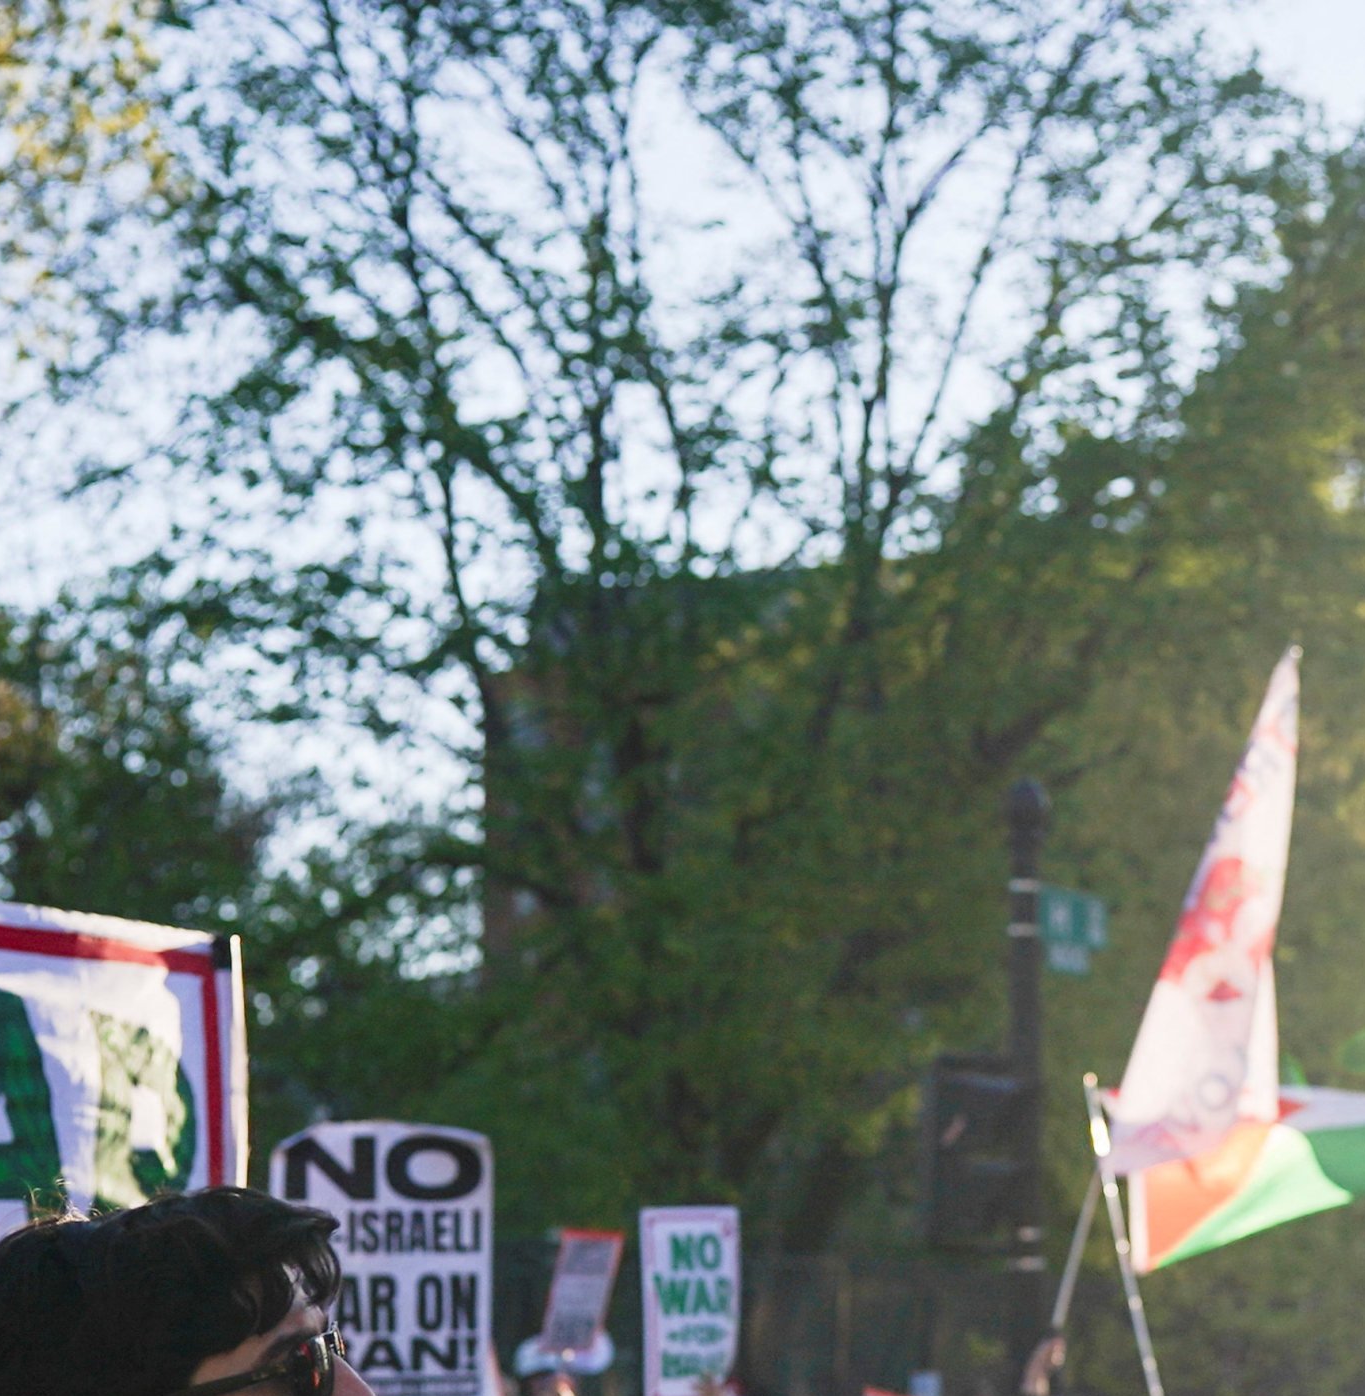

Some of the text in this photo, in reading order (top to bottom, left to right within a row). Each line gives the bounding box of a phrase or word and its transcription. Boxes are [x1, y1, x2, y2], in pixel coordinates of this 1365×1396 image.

[285, 1135, 483, 1200] NO
[334, 1210, 482, 1254] -ISRAELI
[670, 1232, 722, 1272] NO
[337, 1273, 397, 1333] AR
[417, 1272, 478, 1333] ON
[347, 1337, 478, 1372] AN!
